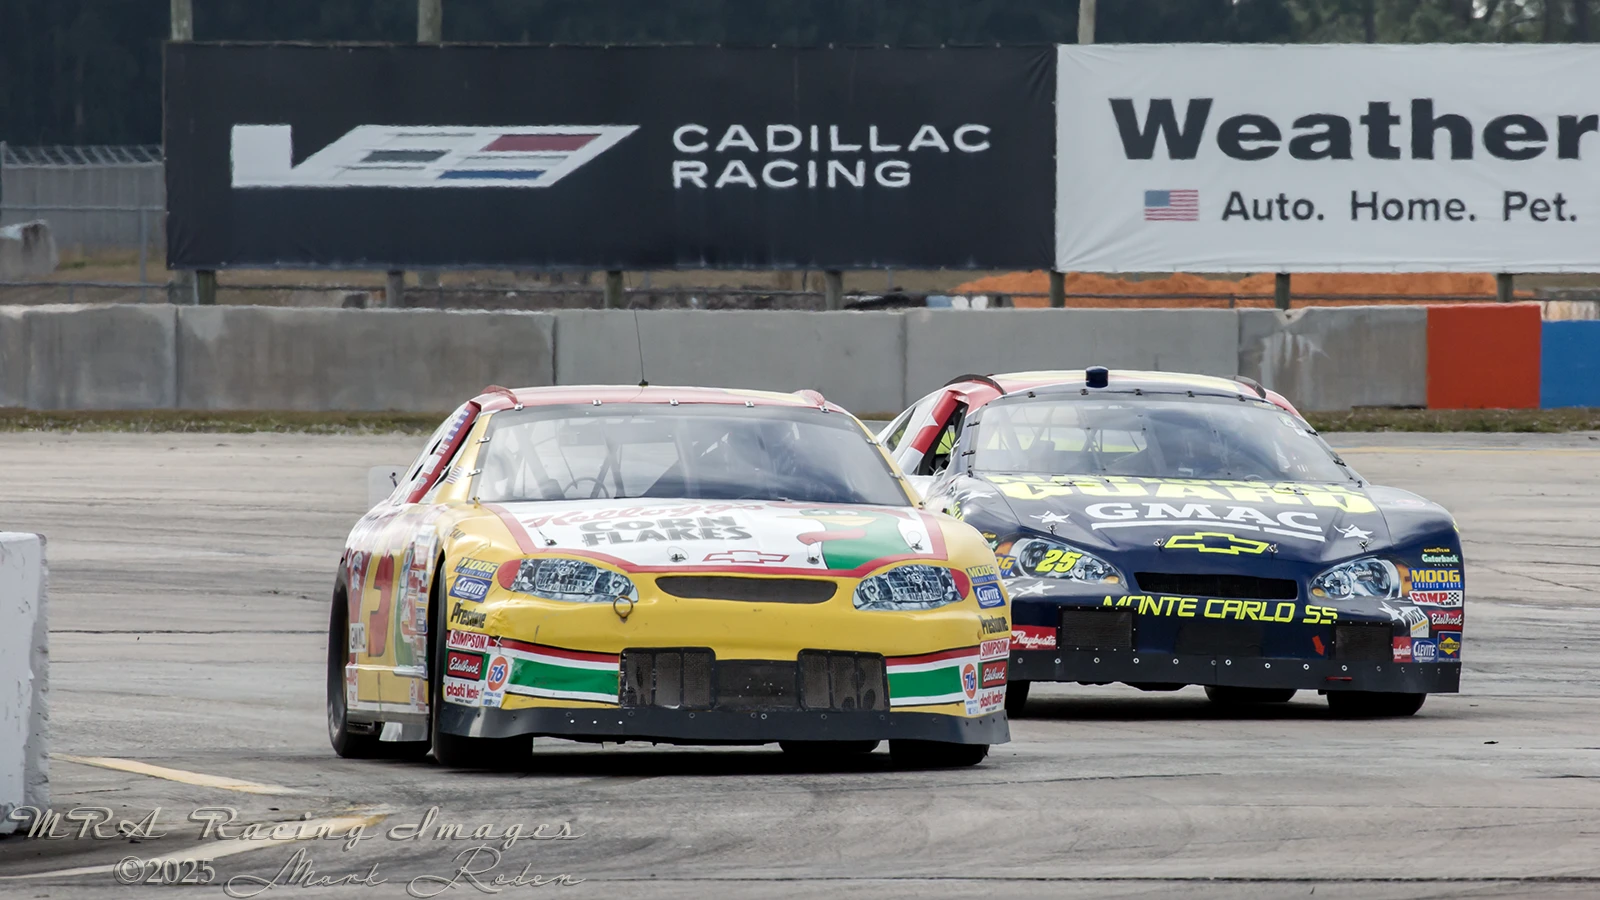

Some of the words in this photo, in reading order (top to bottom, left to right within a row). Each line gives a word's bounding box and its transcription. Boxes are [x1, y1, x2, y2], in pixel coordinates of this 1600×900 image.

[672, 123, 991, 152] CADILLAC
[1108, 98, 1600, 160] Weather
[672, 160, 911, 188] RACING
[1221, 191, 1325, 221] Auto.
[1350, 190, 1476, 221] Home.
[1503, 190, 1578, 221] Pet.
[998, 481, 1377, 514] GUARD
[580, 516, 737, 532] CORN
[1085, 502, 1325, 533] GMAC
[582, 526, 753, 547] FLAKES
[457, 558, 500, 573] MOOG
[1035, 549, 1083, 573] 25
[967, 566, 996, 578] MOOG
[1411, 570, 1460, 582] MOOG
[1411, 592, 1448, 603] COMP
[1204, 599, 1296, 623] CARLO
[1303, 605, 1338, 625] SS
[451, 632, 486, 650] SIMPSON
[981, 641, 1008, 657] SIMPSON
[1413, 641, 1436, 656] CLEVITE
[450, 657, 480, 674] Edelbrock
[489, 664, 507, 683] 76
[965, 670, 975, 691] 76
